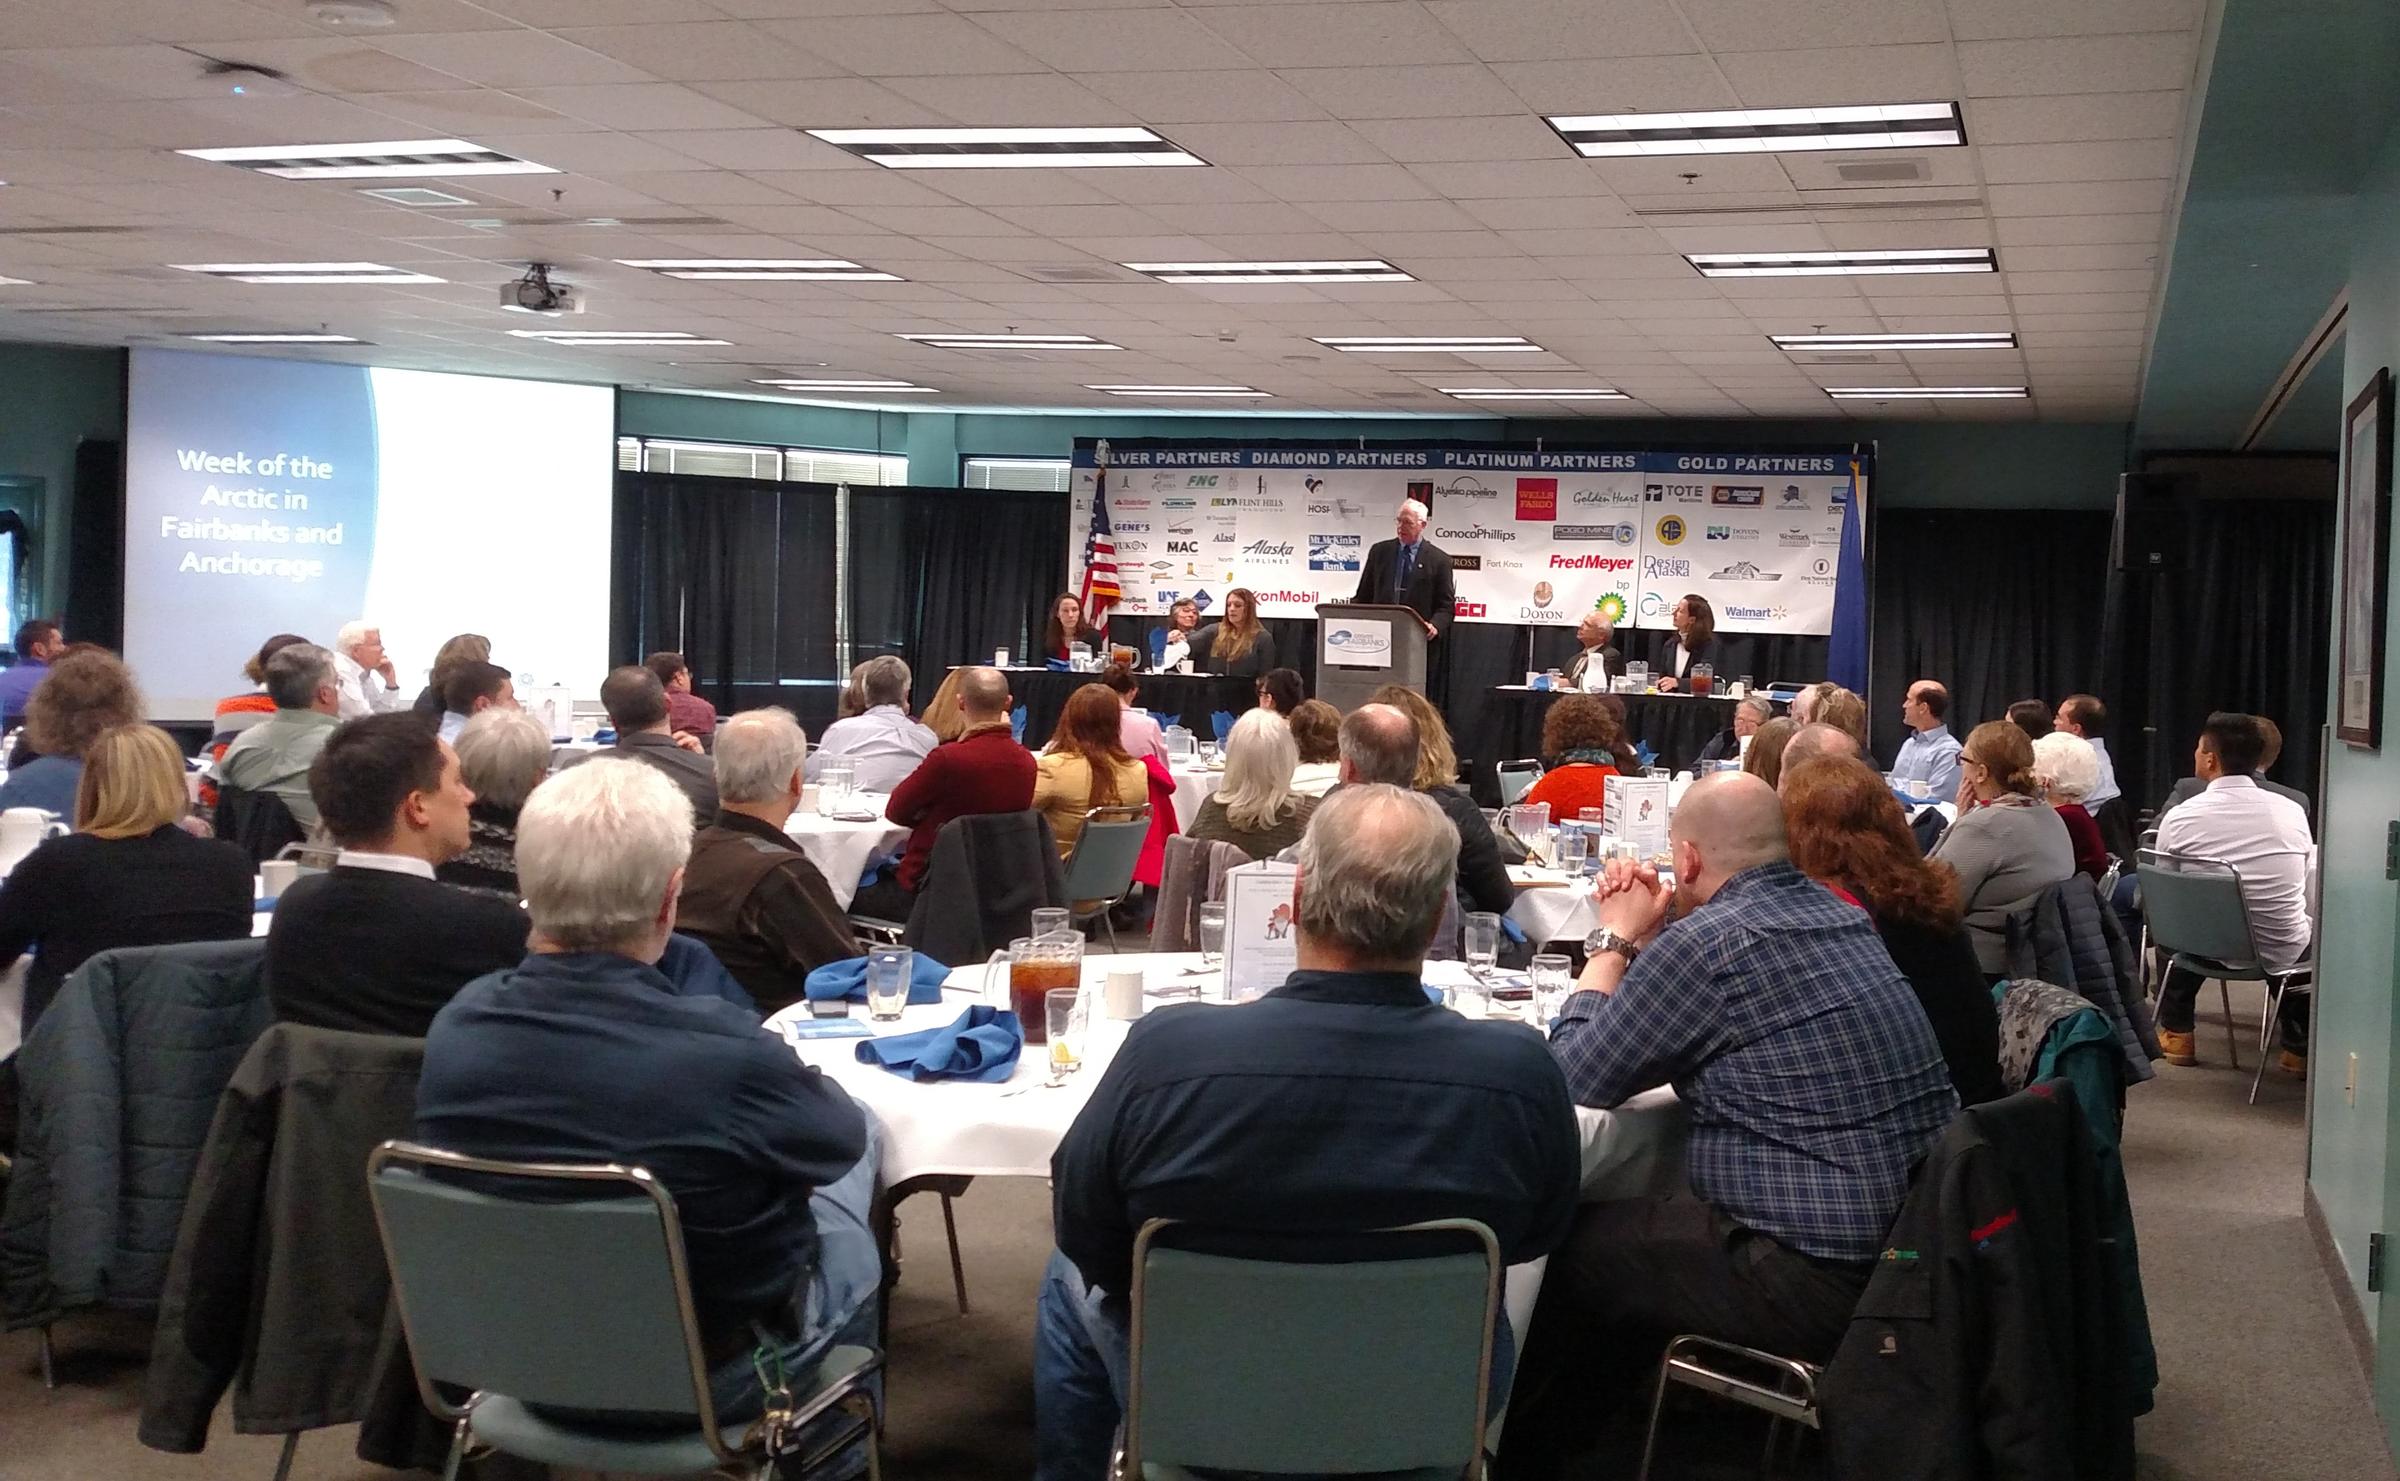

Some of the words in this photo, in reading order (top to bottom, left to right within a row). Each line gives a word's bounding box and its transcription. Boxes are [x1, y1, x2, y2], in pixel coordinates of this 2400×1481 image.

[1156, 452, 1241, 464] PARTNERS
[1252, 453, 1330, 465] DIAMOND
[1337, 453, 1427, 465] PARTNERS
[1445, 453, 1533, 467] PLATINUM
[1541, 455, 1636, 468] PARTNERS
[1678, 457, 1728, 470] GOLD
[1735, 458, 1834, 471] PARTNERS
[177, 449, 252, 474] Week
[257, 453, 288, 476] of
[290, 456, 333, 480] the
[1187, 475, 1219, 486] FNG
[1436, 486, 1464, 497] Alyeska
[1466, 486, 1497, 497] pipeline
[1519, 491, 1554, 499] WELLS
[1666, 485, 1703, 496] TOTE
[200, 485, 278, 510] Arctic
[284, 489, 308, 510] in
[1573, 491, 1609, 503] Golden
[1612, 491, 1639, 503] Heart
[1239, 499, 1259, 507] FLINT
[1263, 499, 1284, 508] HILLS
[1519, 500, 1553, 508] FARGO
[161, 516, 290, 544] Fairbanks
[295, 522, 343, 545] and
[1114, 523, 1150, 532] GENE'S
[1587, 527, 1612, 535] MINE
[1435, 527, 1516, 542] ConocoPhillips
[1167, 541, 1198, 552] MAC
[1242, 539, 1294, 557] Alaska
[178, 551, 324, 582] Anchorage
[1323, 561, 1346, 571] Bank
[1486, 559, 1502, 568] Fort
[1503, 560, 1523, 568] Knox
[1644, 555, 1690, 570] Design
[1645, 565, 1690, 579] Alaska
[1616, 580, 1630, 590] bp
[1455, 603, 1486, 617] GCI
[1725, 606, 1771, 618] Walmart
